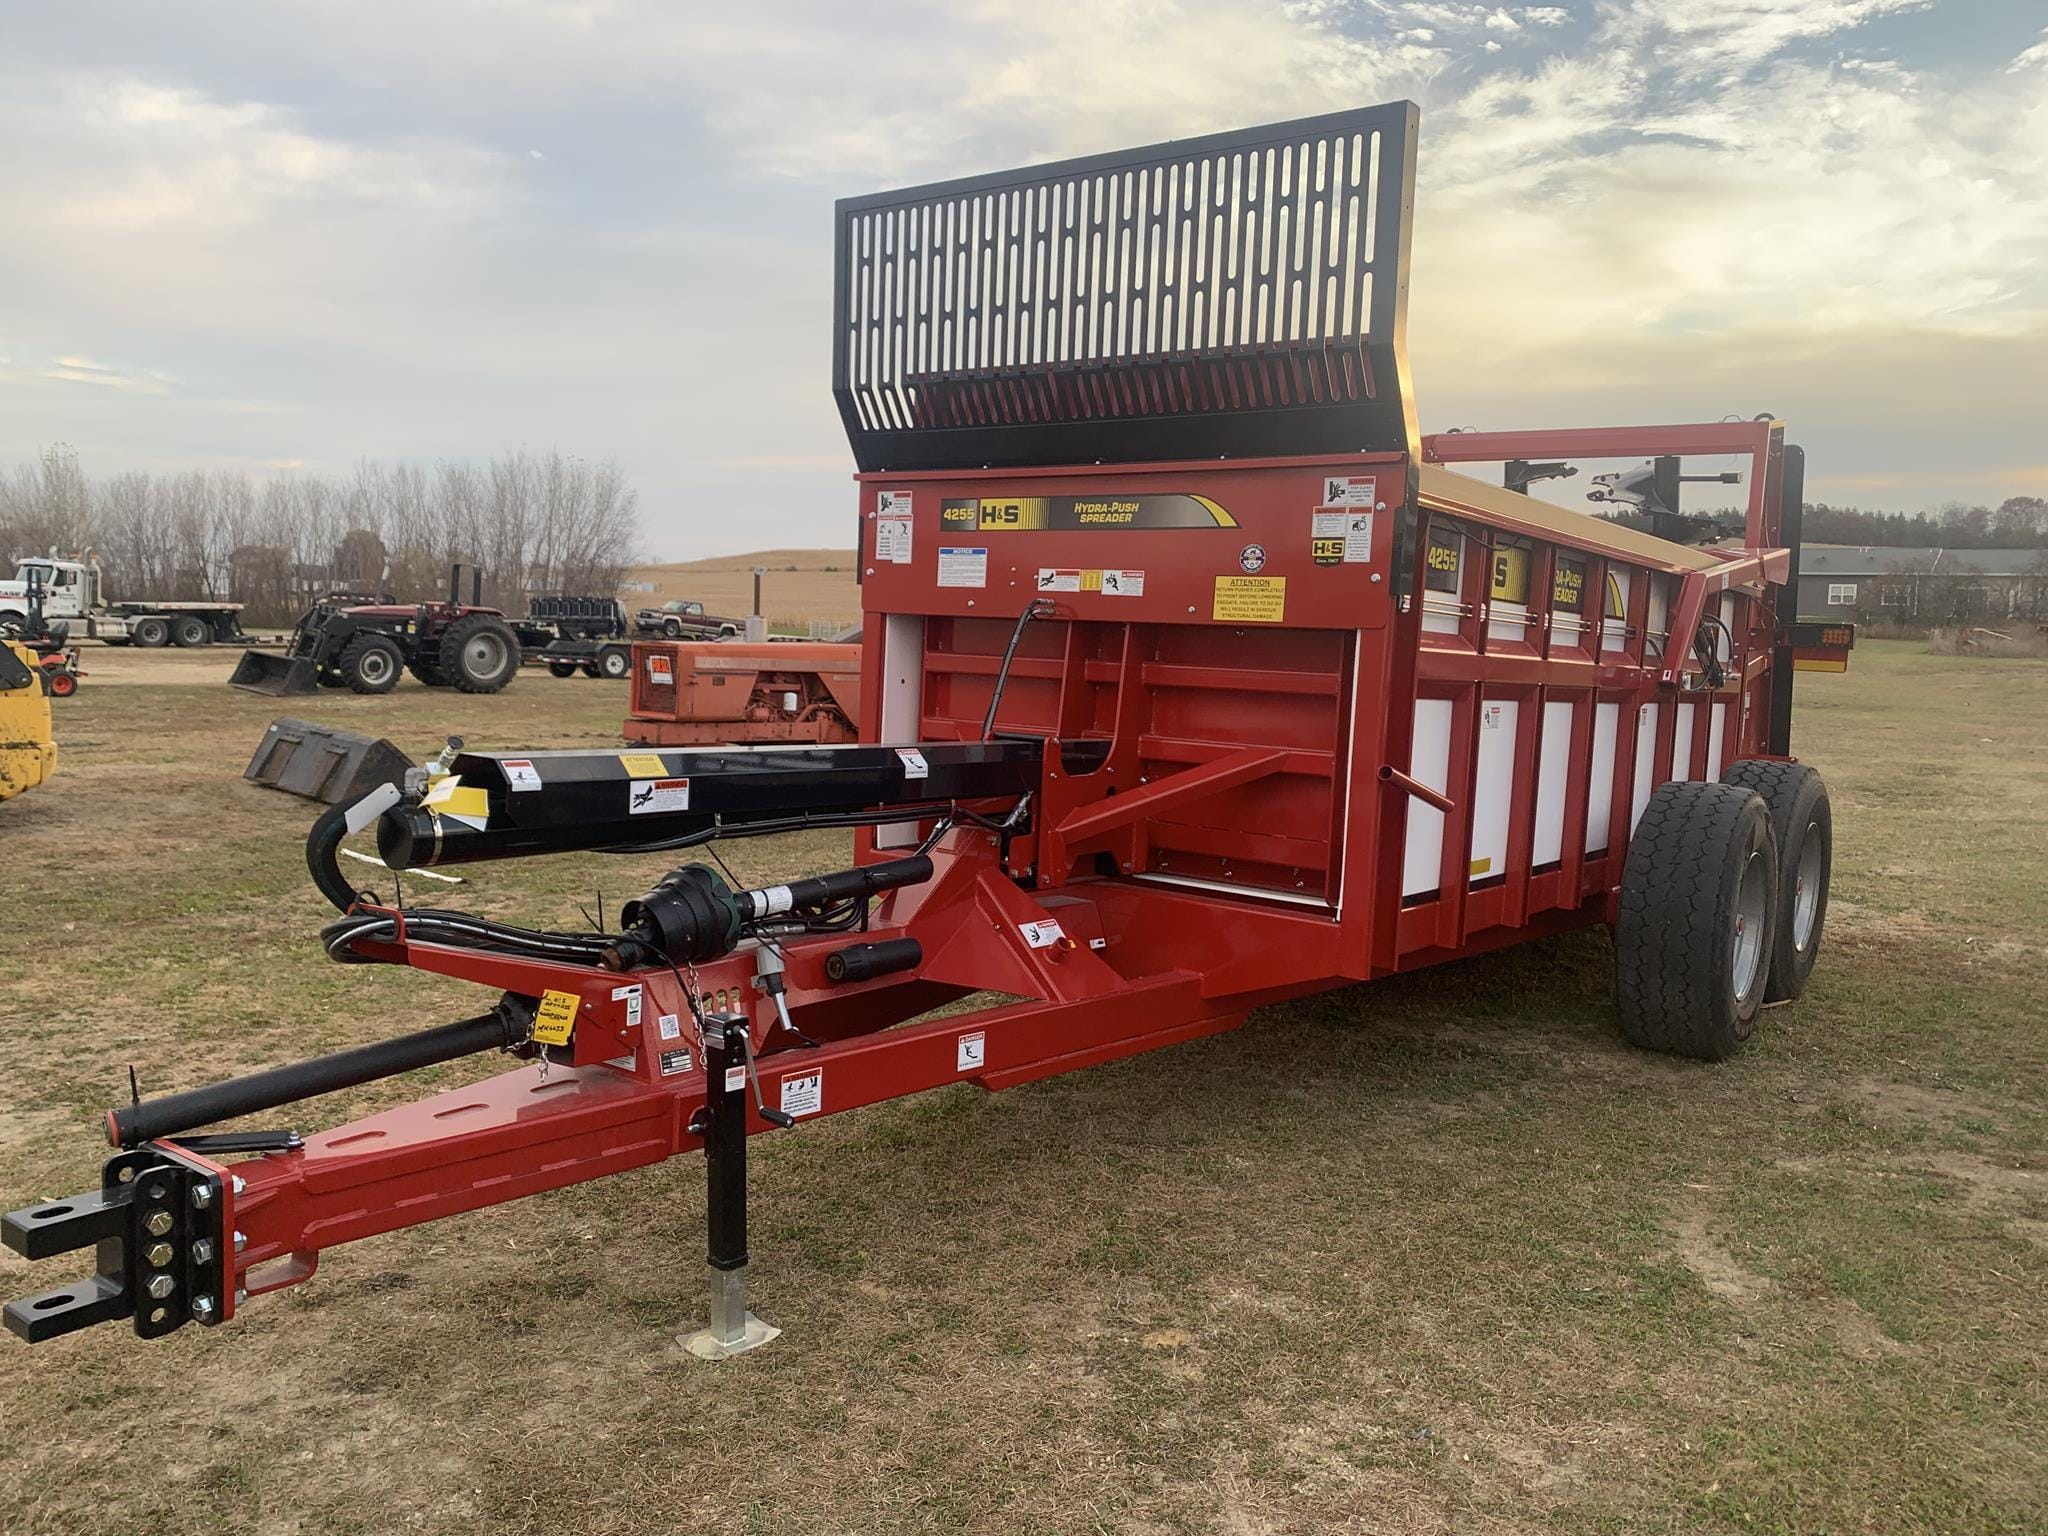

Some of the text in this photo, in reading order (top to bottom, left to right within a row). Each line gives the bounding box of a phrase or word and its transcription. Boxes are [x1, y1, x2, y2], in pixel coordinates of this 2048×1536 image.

[1074, 502, 1140, 513] HYDRA-PUSH
[943, 508, 975, 521] 4255
[981, 505, 1019, 524] H&S
[1080, 513, 1132, 523] SPREADER
[1314, 542, 1343, 554] H&S
[1427, 546, 1457, 572] 4255
[1230, 579, 1271, 587] ATTENTION
